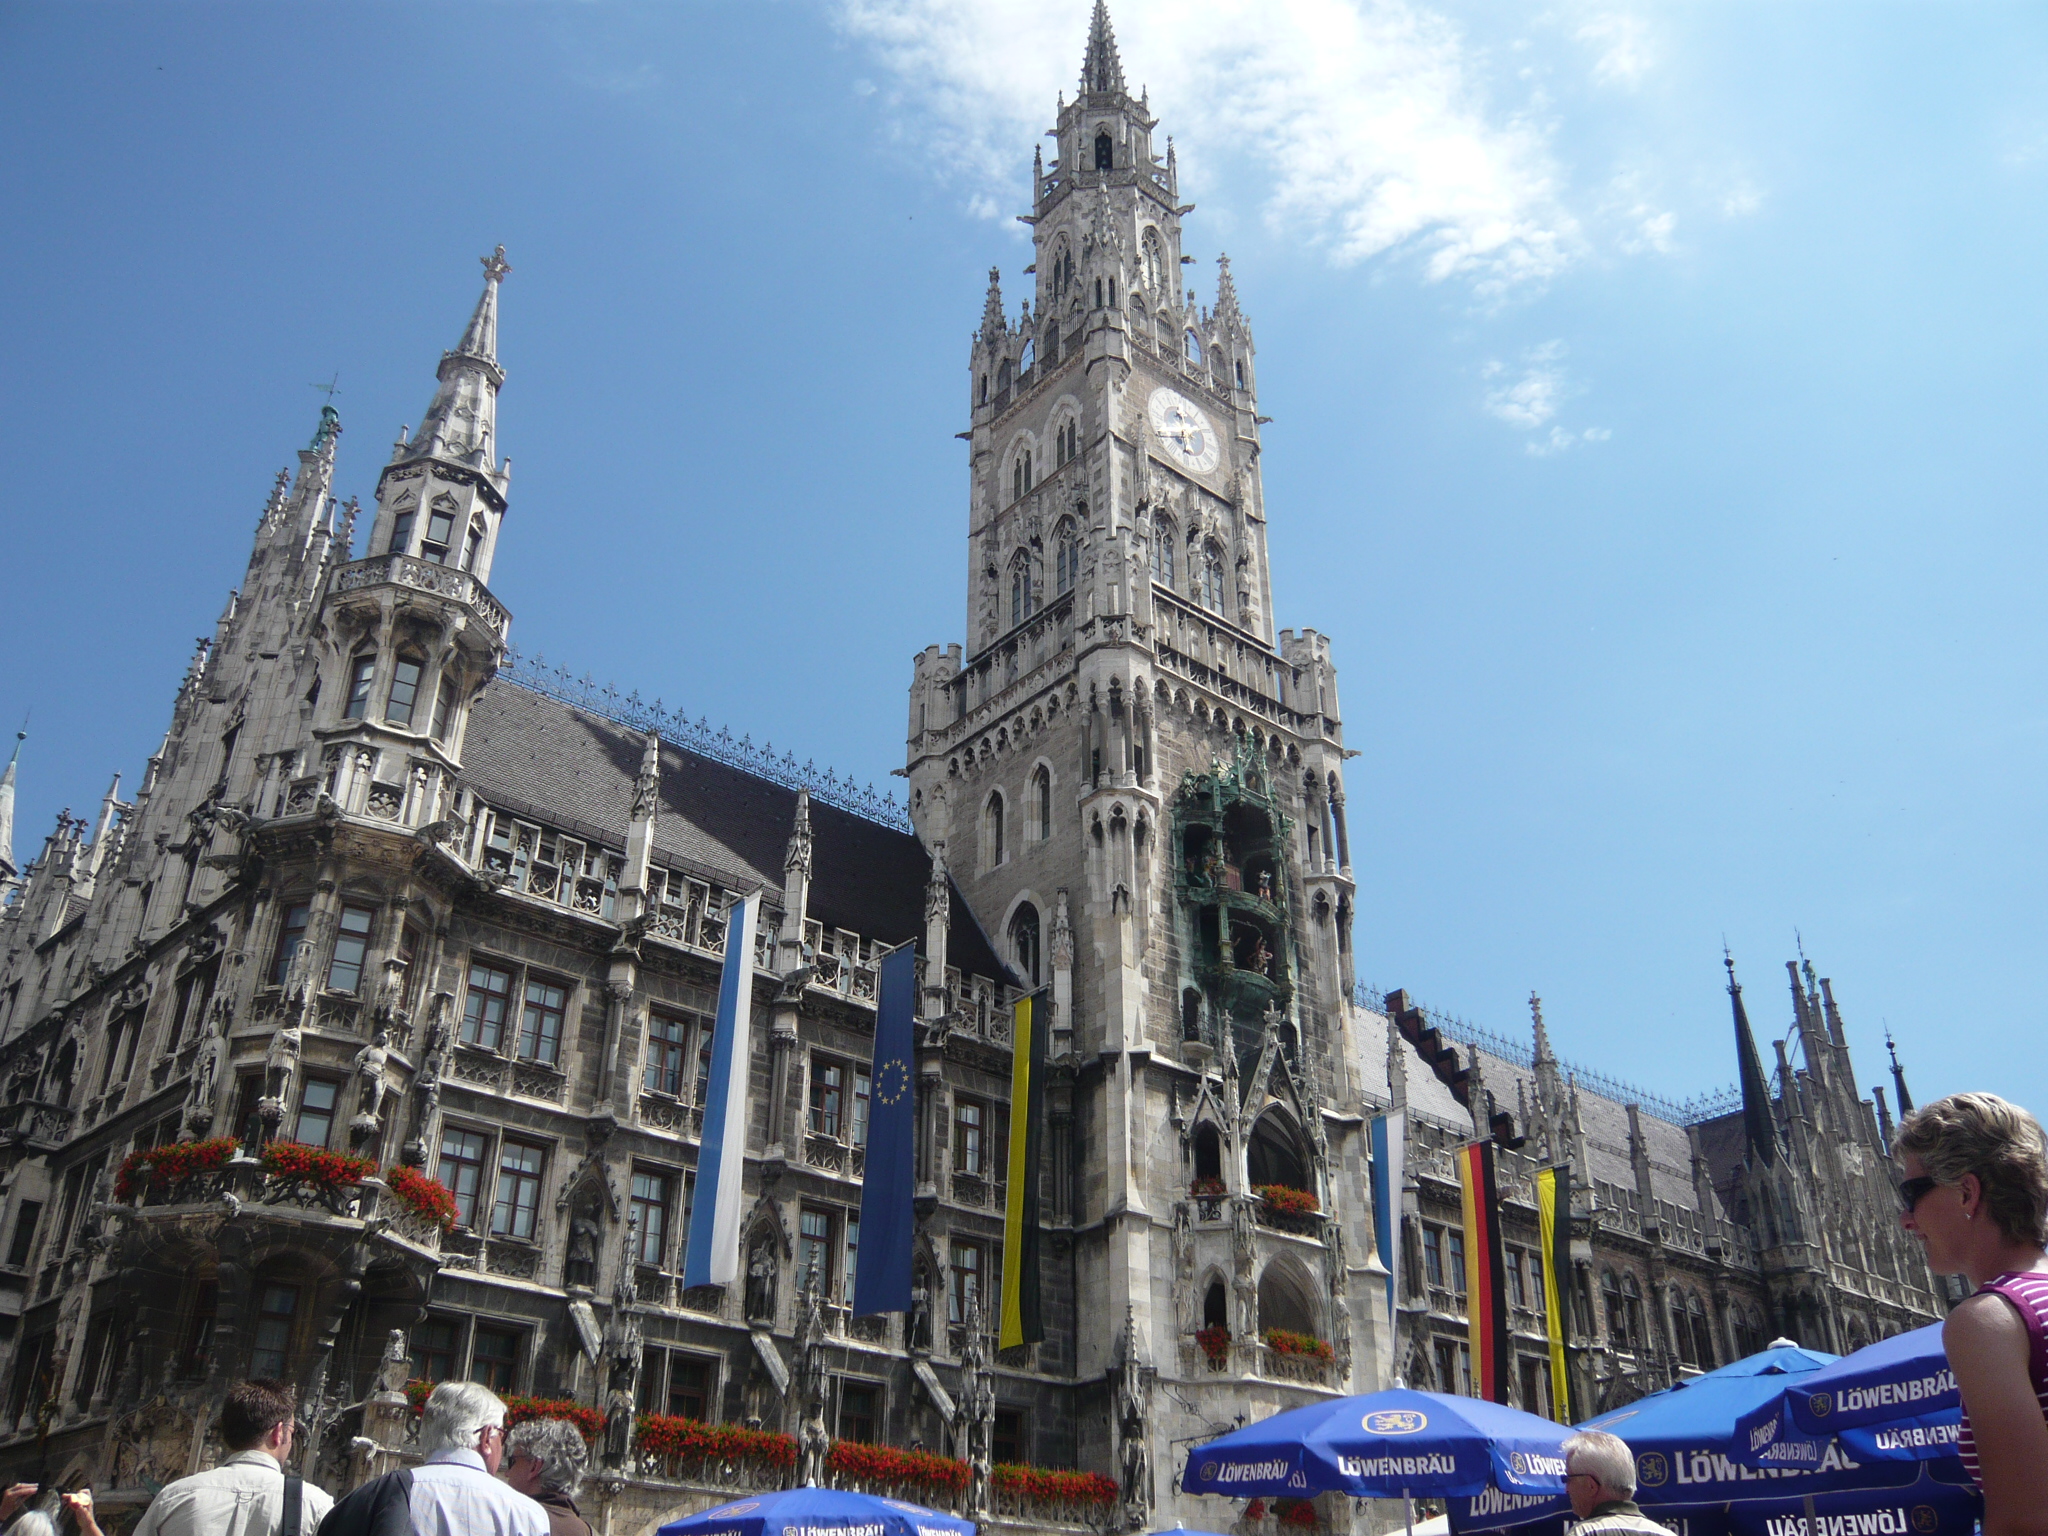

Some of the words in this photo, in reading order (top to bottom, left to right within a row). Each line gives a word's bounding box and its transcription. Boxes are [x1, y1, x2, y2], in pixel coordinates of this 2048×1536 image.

[1217, 1459, 1289, 1483] LÖWENBRÄU
[1337, 1453, 1456, 1477] LÖWENBRÄU
[1525, 1453, 1568, 1476] LÖWEN
